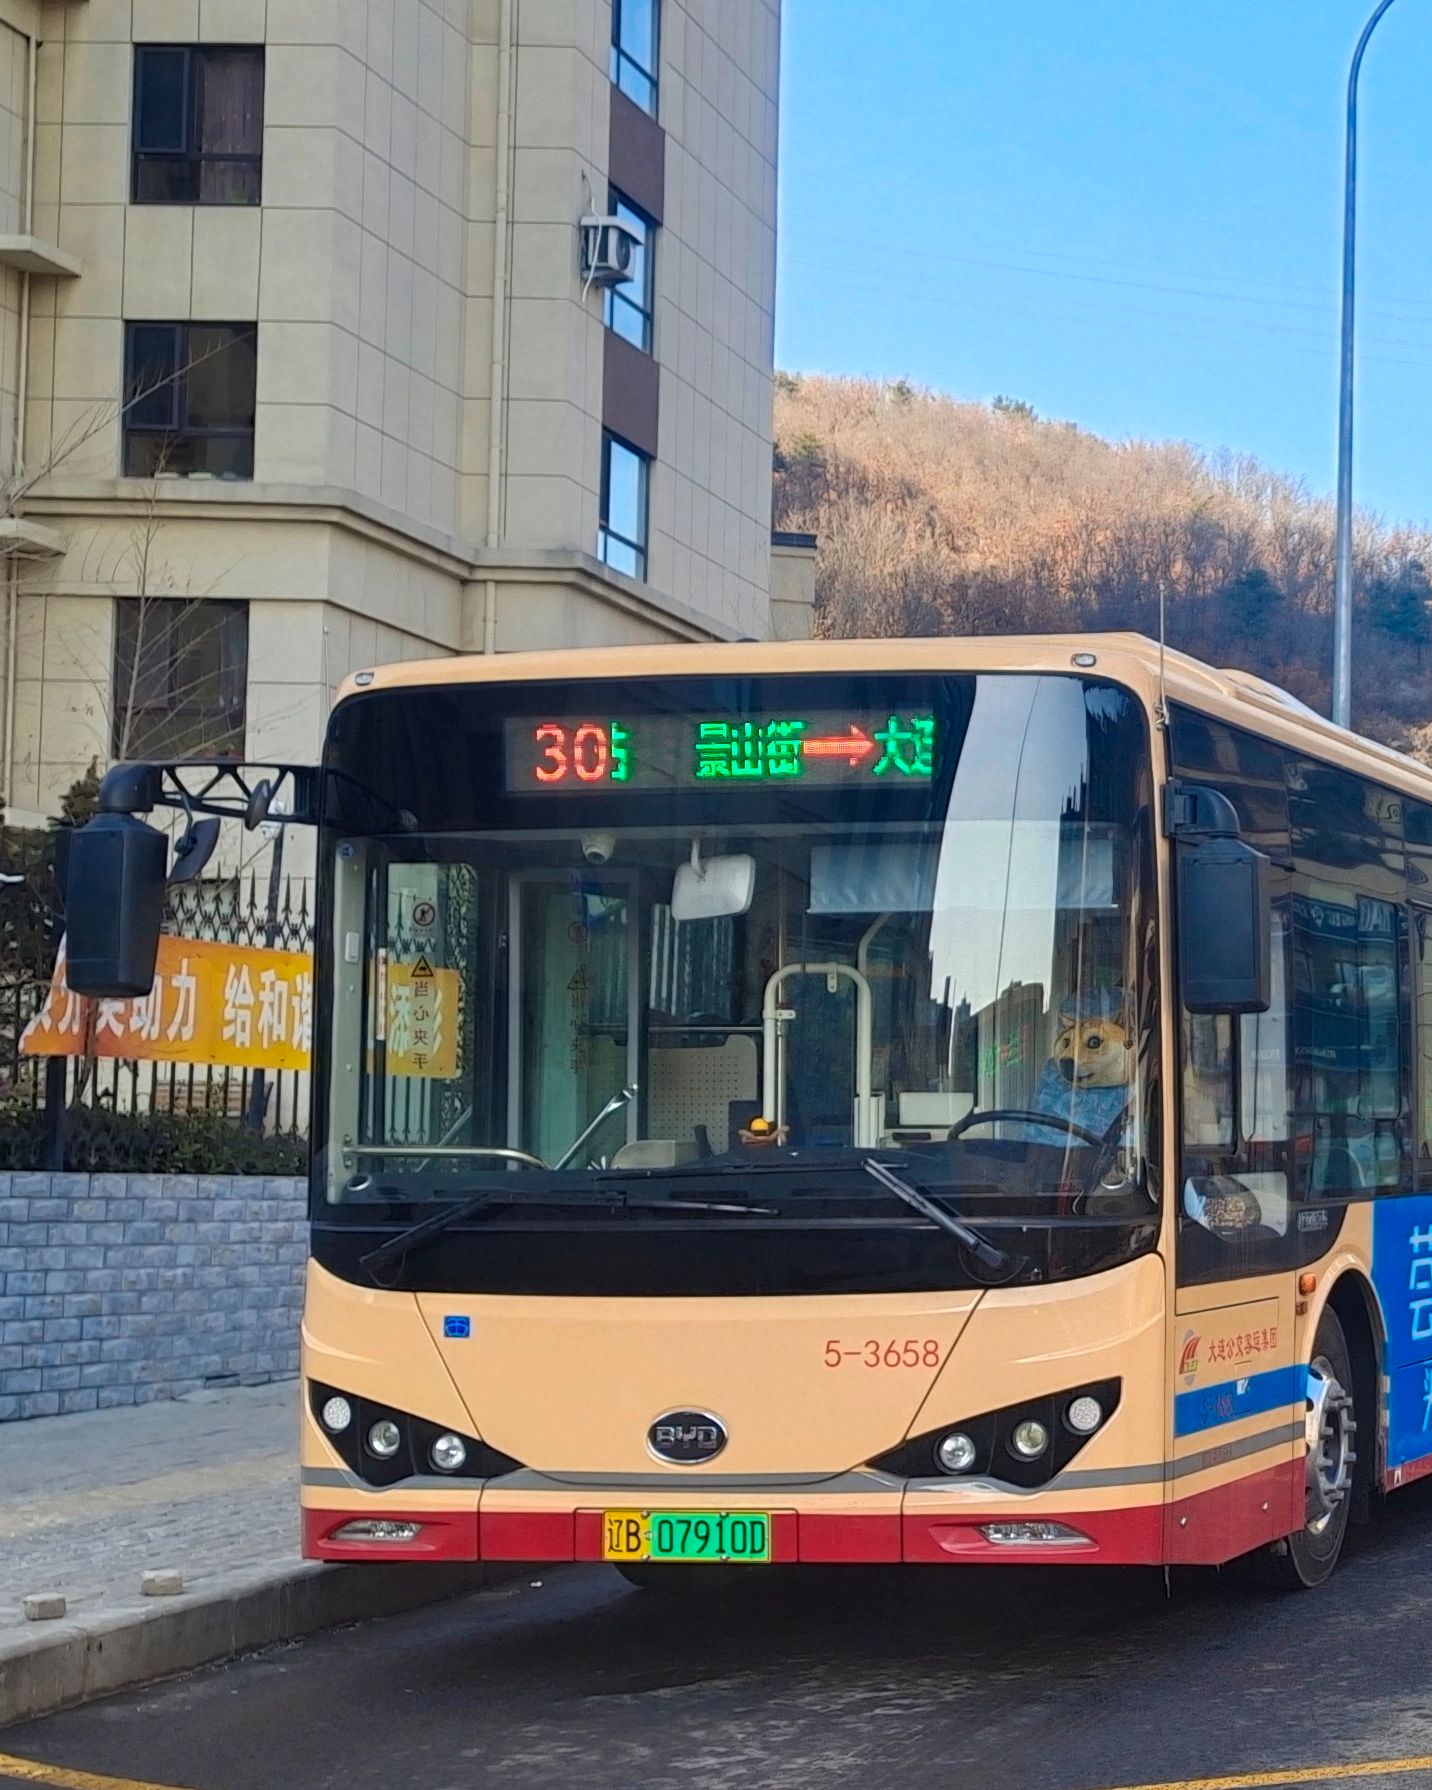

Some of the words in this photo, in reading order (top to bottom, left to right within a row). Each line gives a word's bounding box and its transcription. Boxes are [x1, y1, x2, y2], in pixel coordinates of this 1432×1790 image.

[824, 1339, 940, 1368] 5-3658
[1207, 1327, 1278, 1363] 大连公交客运集团
[656, 1426, 718, 1449] BYD
